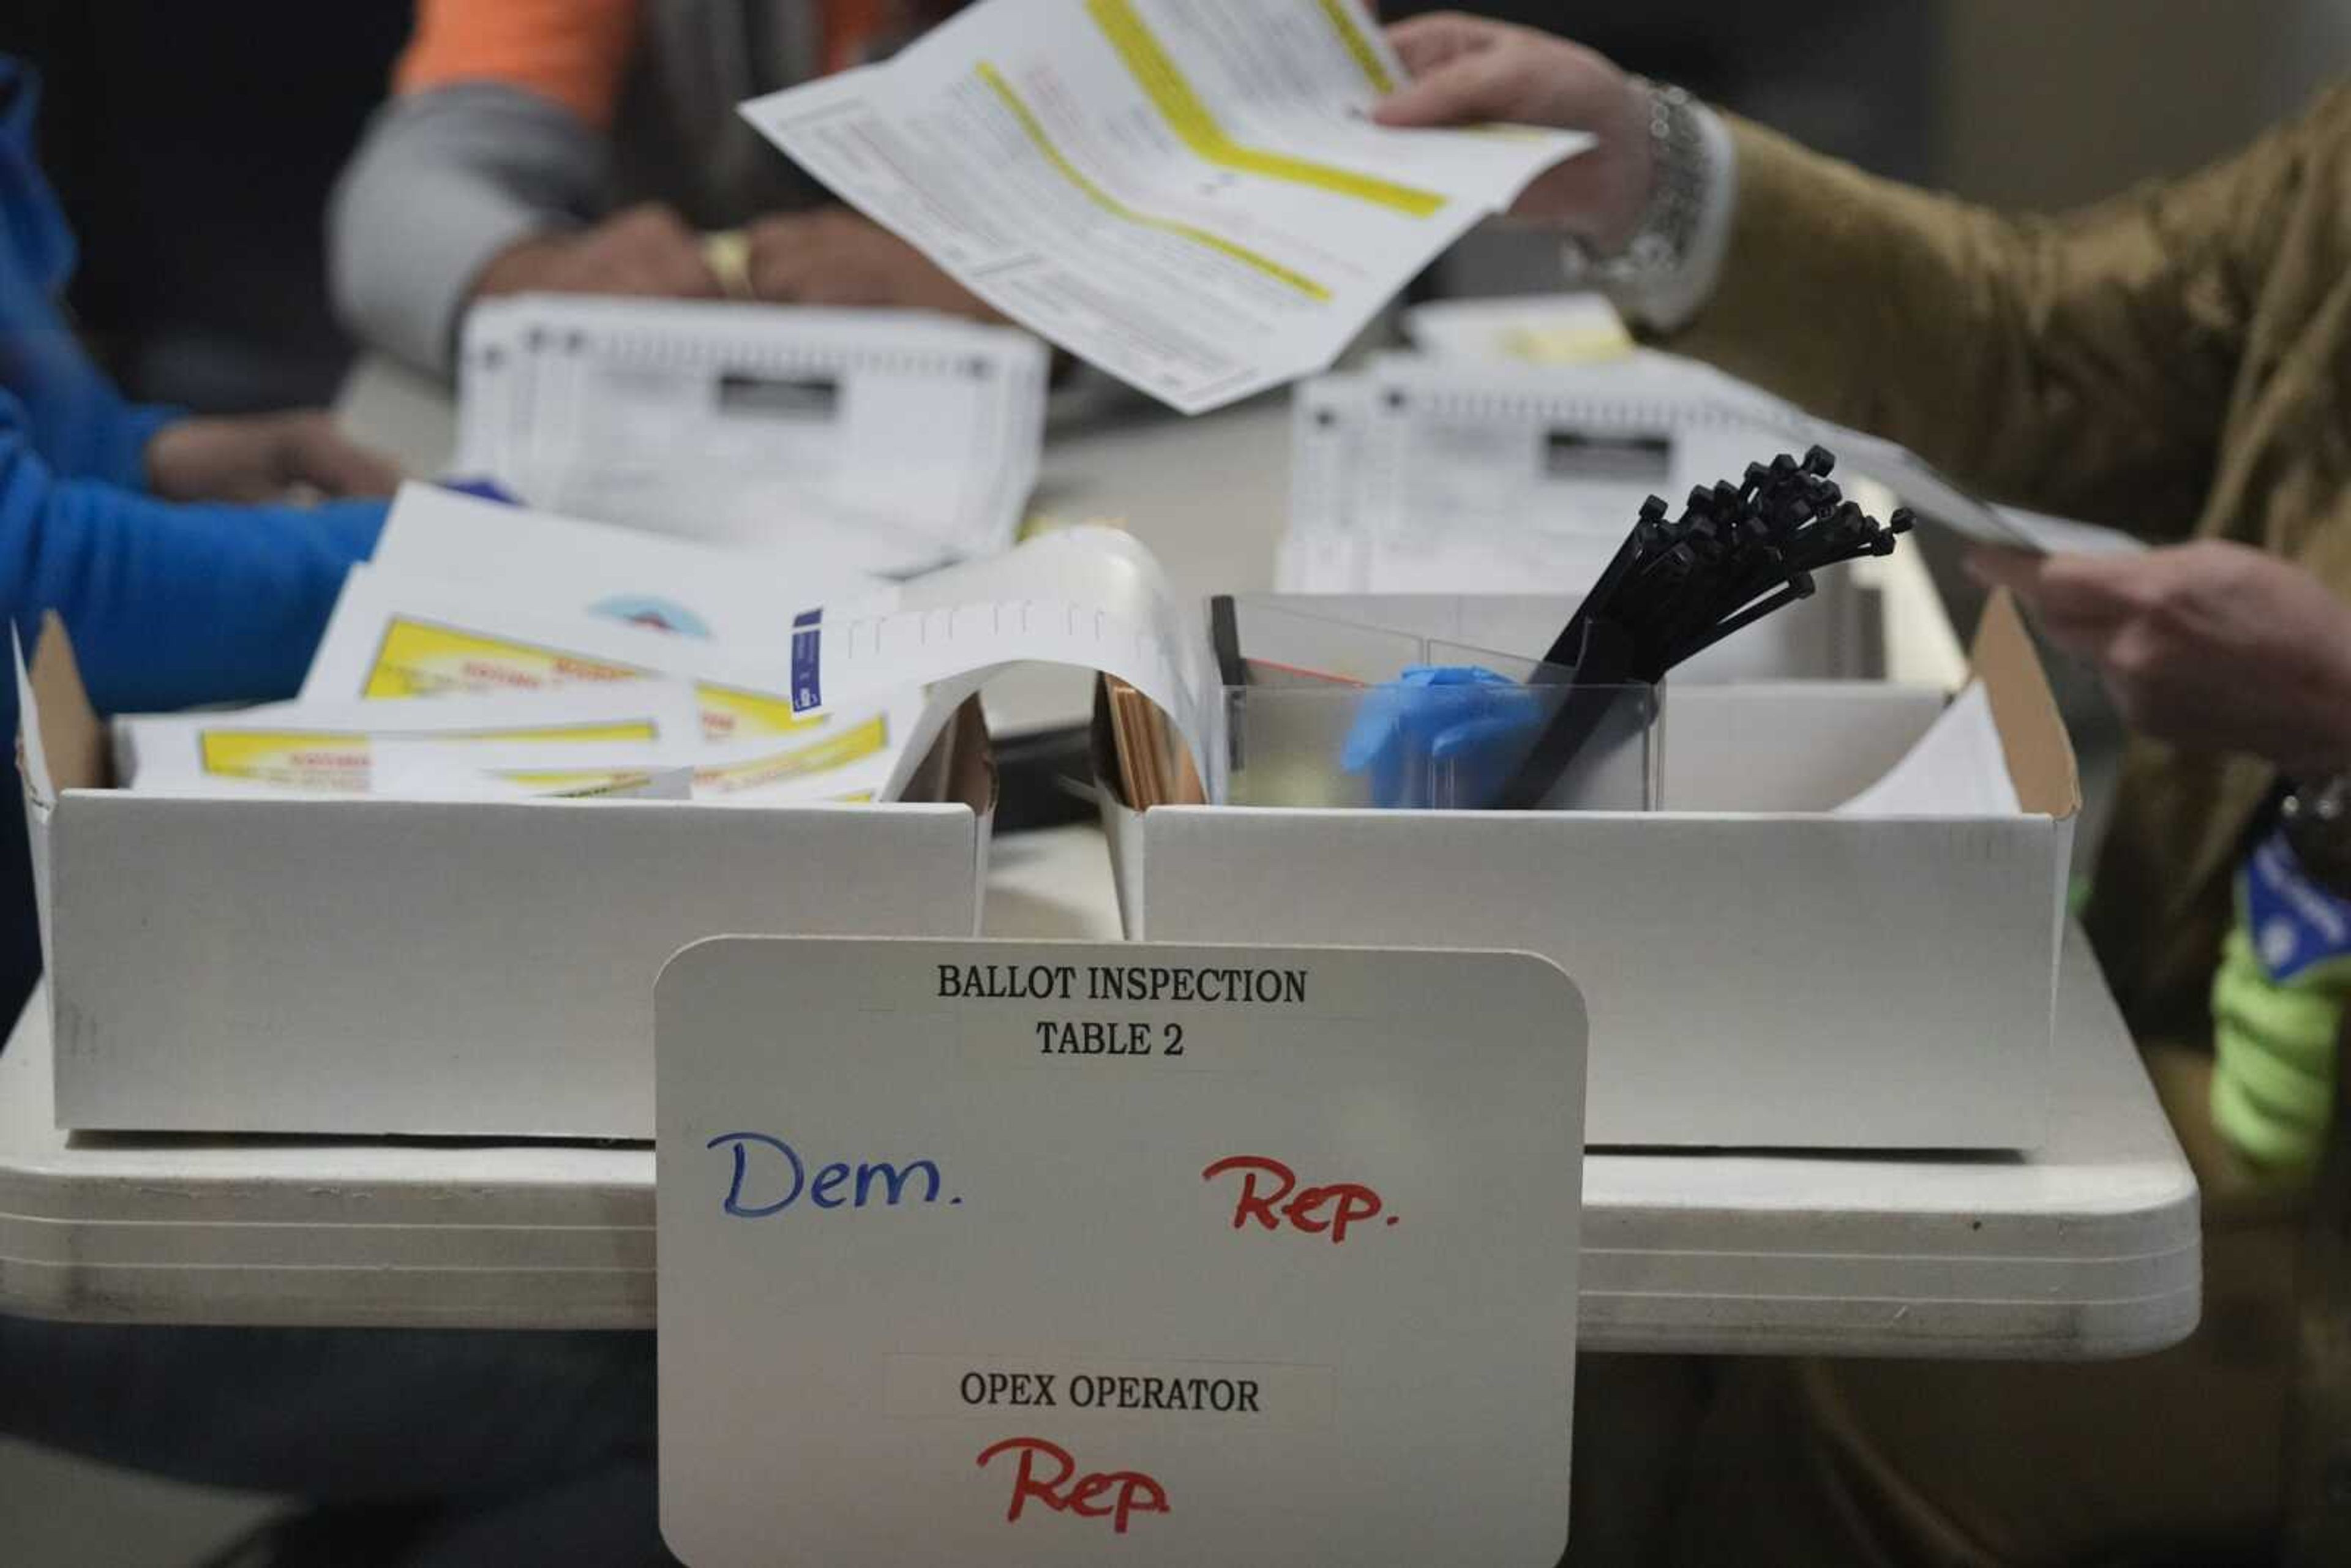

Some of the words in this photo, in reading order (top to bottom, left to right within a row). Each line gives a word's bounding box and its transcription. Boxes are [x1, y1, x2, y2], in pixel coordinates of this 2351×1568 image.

[937, 964, 1077, 1000] BALLOT
[1086, 966, 1308, 1004] INSPECTION
[1036, 1021, 1152, 1056] TABLE
[1163, 1022, 1185, 1057] 2
[707, 1131, 963, 1218] Dem.
[1204, 1156, 1398, 1243] Rep.
[960, 1371, 1057, 1407] OPEX
[1069, 1375, 1260, 1413] OPERATOR
